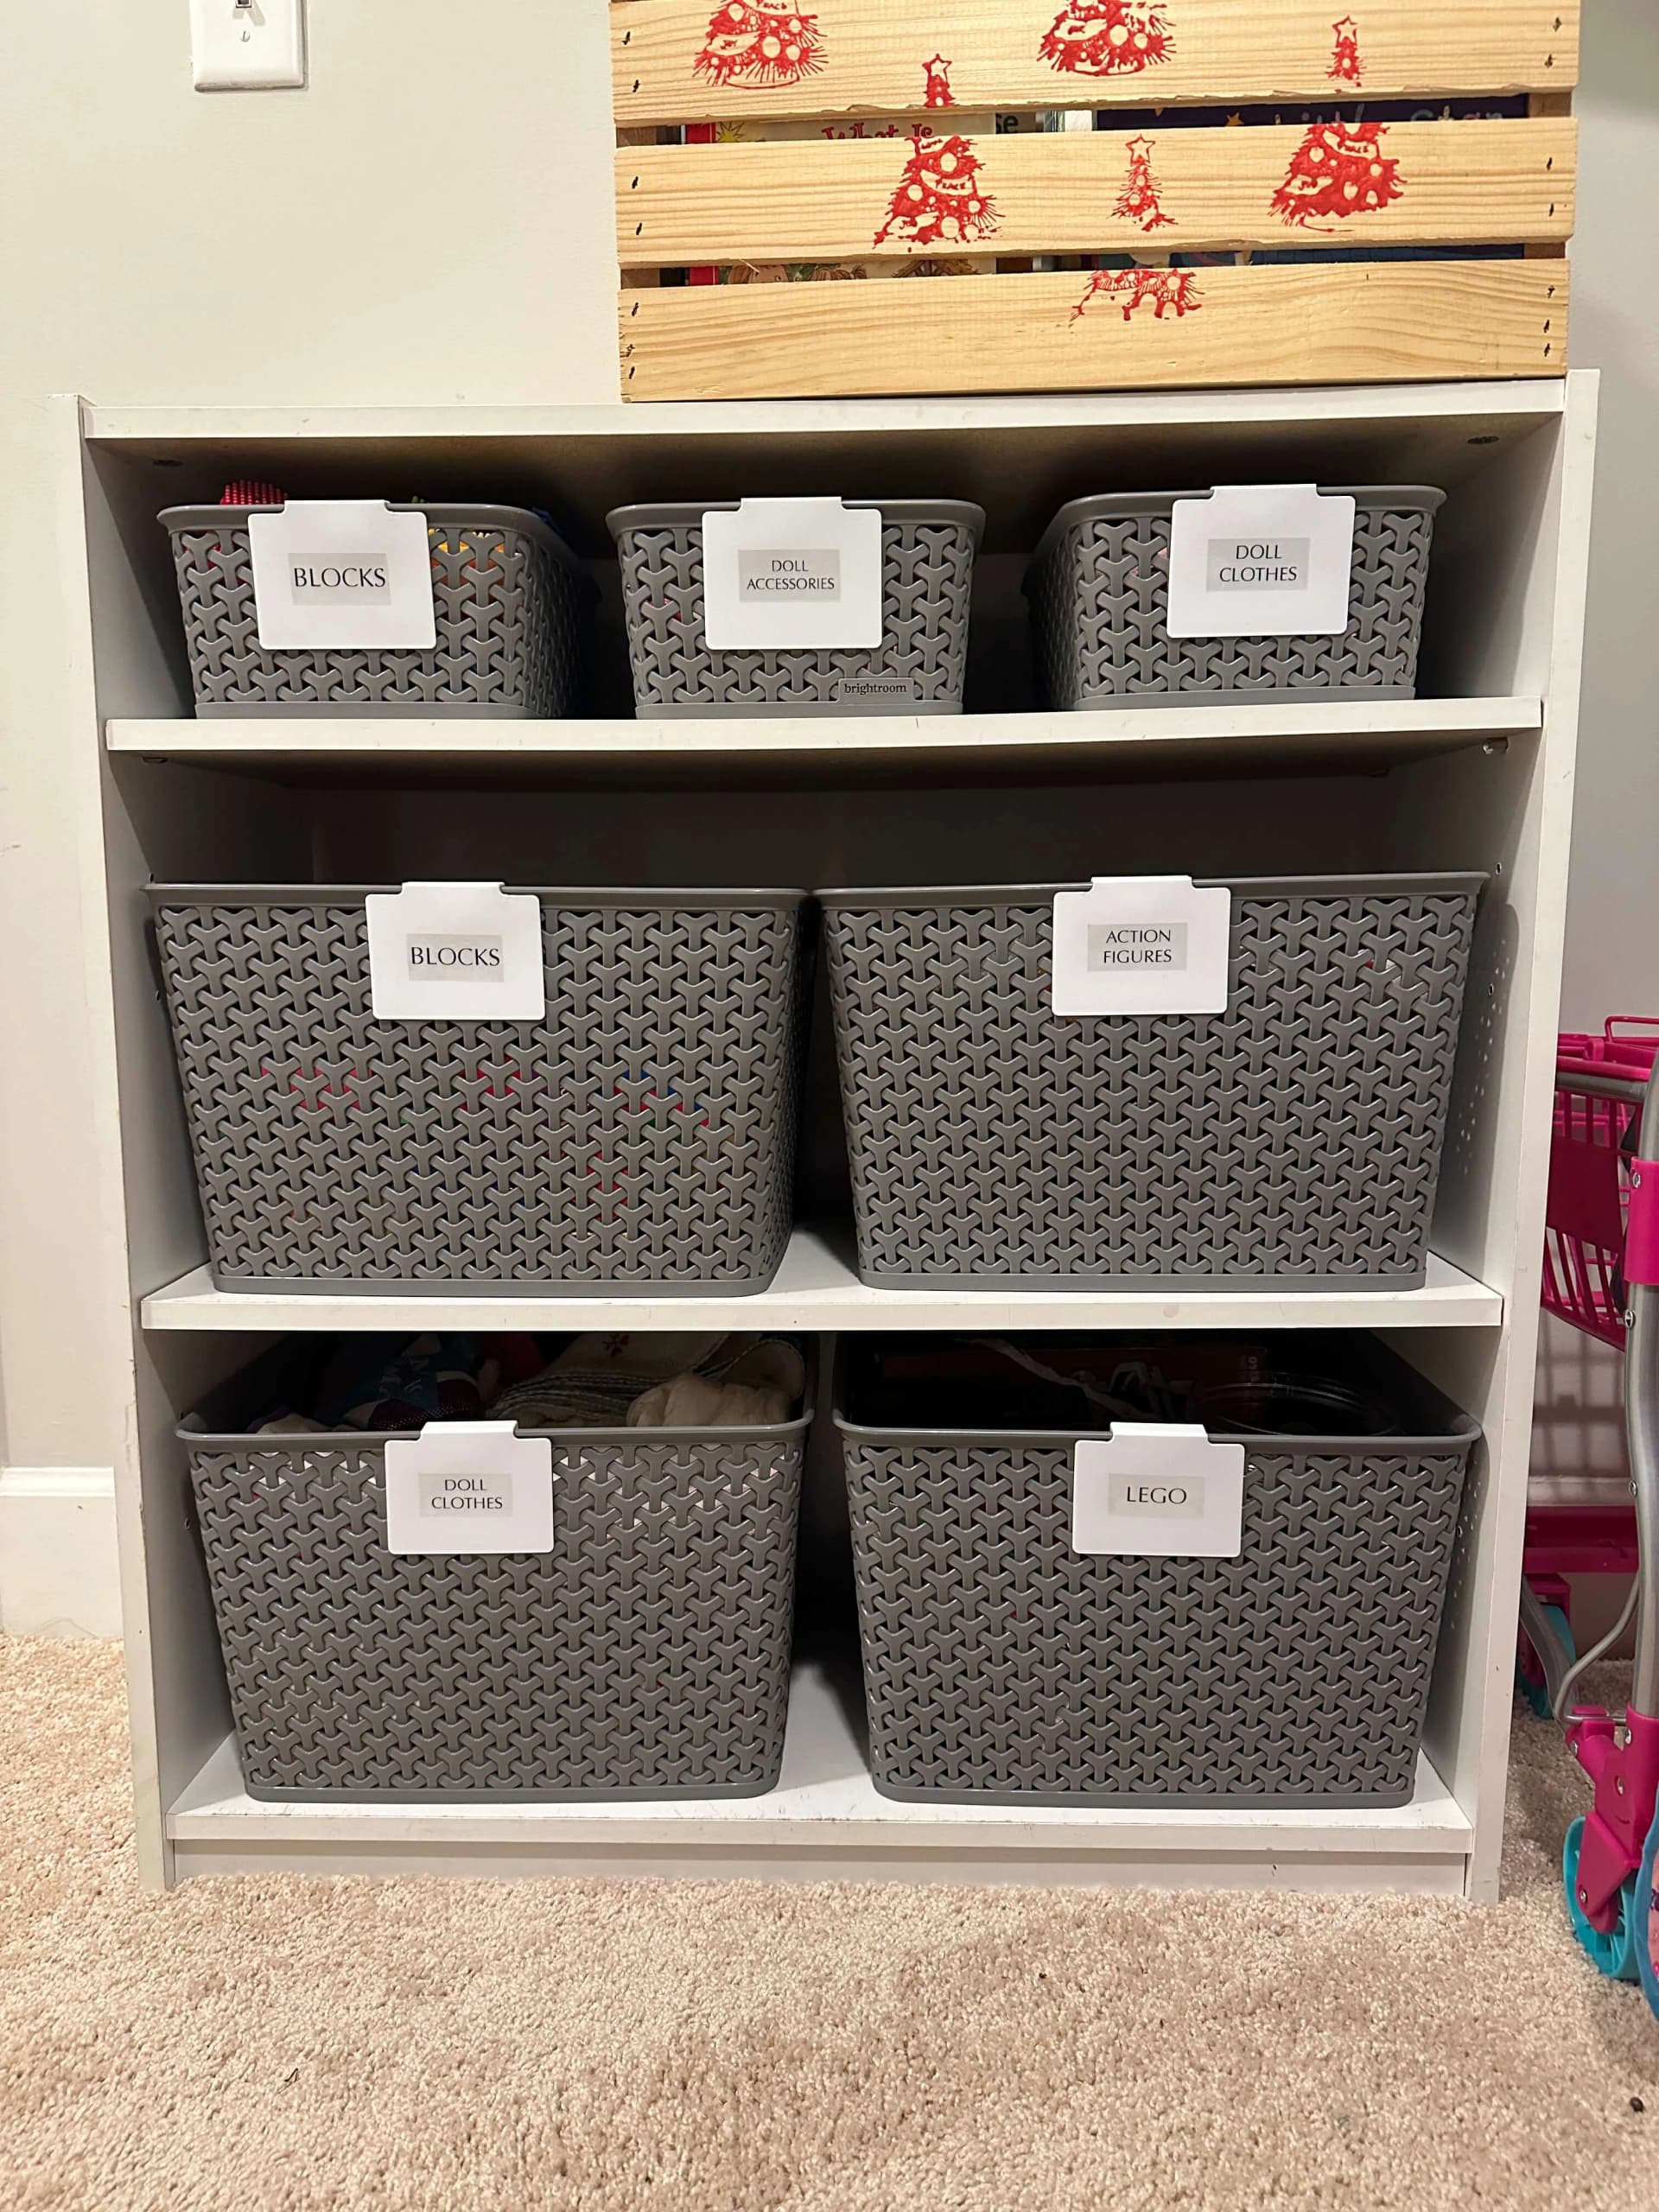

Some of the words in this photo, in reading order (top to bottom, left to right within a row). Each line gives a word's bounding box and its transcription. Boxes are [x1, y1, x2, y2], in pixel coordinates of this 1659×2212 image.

[1236, 544, 1282, 560] DOLL
[772, 559, 809, 572] DOLL
[294, 567, 386, 588] BLOCKS
[1219, 566, 1297, 582] CLOTHES
[747, 577, 835, 590] ACCESSORIES
[843, 683, 907, 696] brightroom
[1105, 929, 1172, 944] ACTION
[411, 946, 500, 967] BLOCKS
[1103, 949, 1172, 963] FIGURES
[444, 1478, 487, 1491] DOLL
[1126, 1486, 1187, 1504] LEGO
[431, 1497, 503, 1510] CLOTHES
